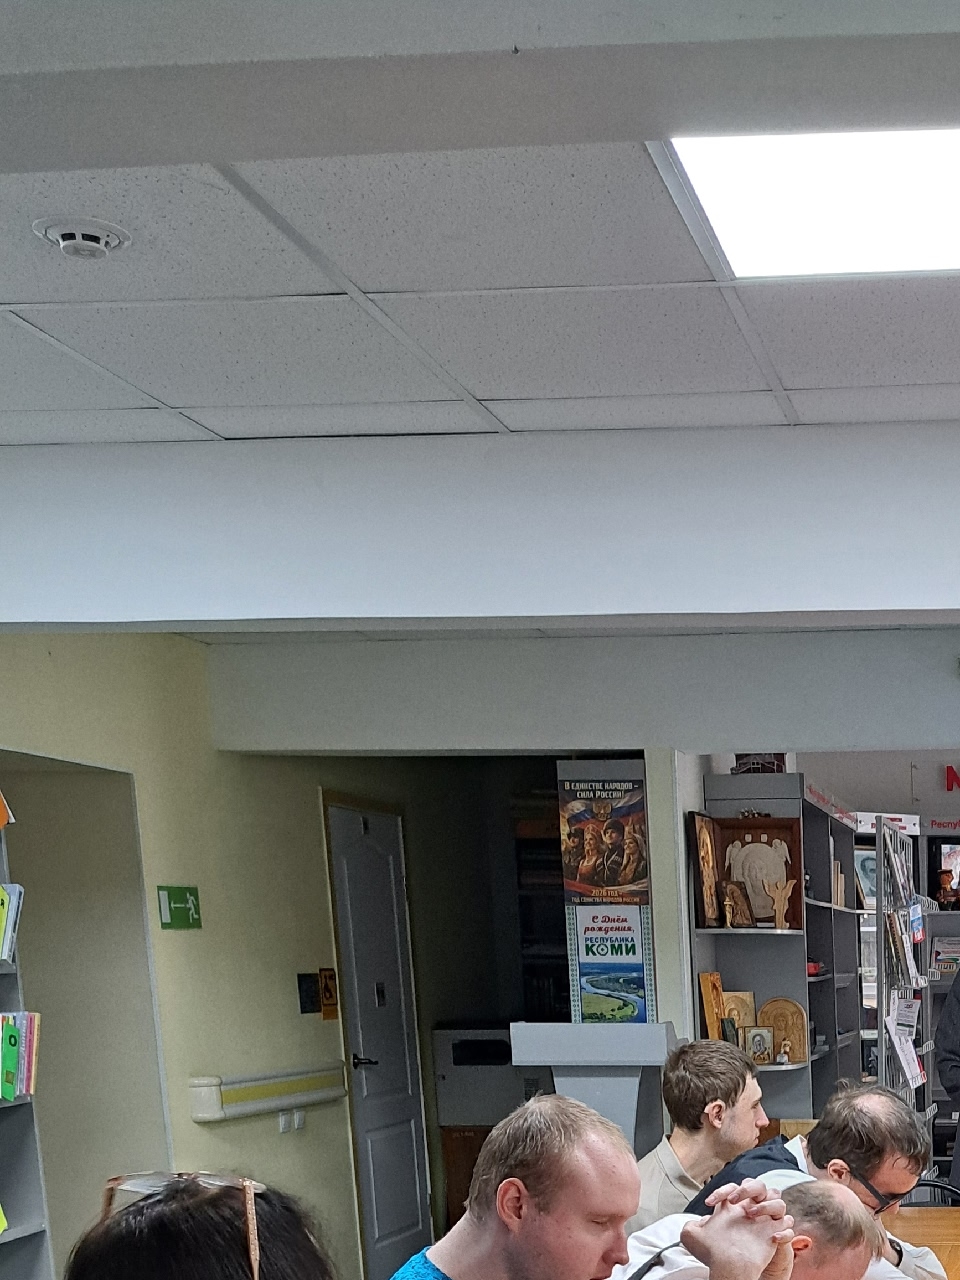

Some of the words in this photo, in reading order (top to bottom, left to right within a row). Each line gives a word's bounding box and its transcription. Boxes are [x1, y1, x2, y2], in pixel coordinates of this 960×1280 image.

[564, 782, 570, 790] В
[571, 782, 603, 790] ЕДИНСТВЕ
[604, 782, 633, 790] НАРОДОВ
[576, 791, 594, 799] СИЛА
[592, 915, 599, 923] С
[601, 915, 628, 923] Днём
[584, 926, 635, 936] рождения,
[585, 943, 636, 957] КОМИ
